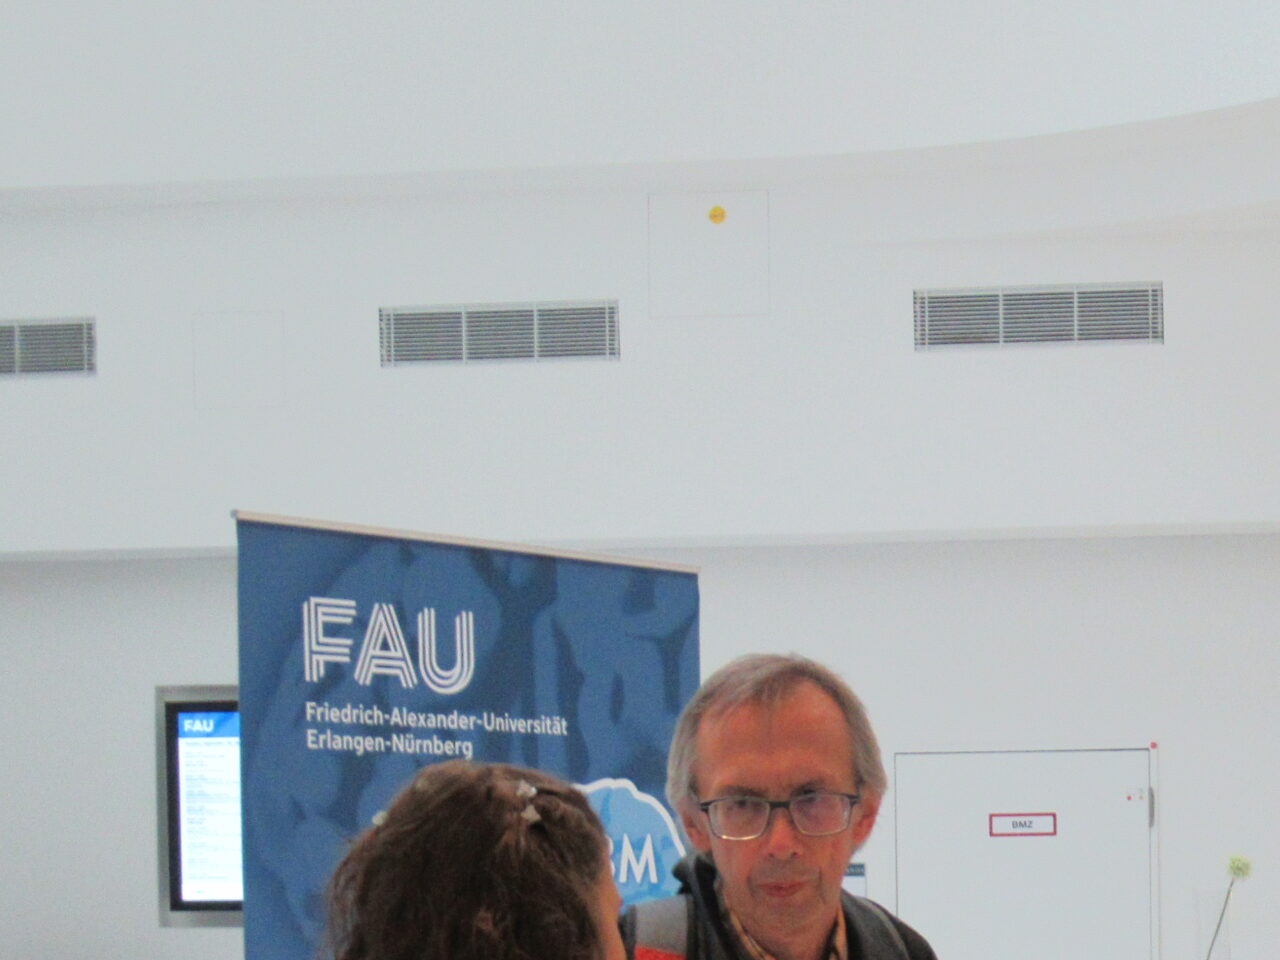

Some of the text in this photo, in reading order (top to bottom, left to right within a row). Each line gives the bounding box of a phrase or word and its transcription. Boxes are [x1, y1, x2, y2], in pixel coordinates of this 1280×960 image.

[303, 596, 475, 695] FAU
[183, 719, 214, 733] FAU
[305, 701, 568, 736] Friedrich-Alexander-Universität
[306, 729, 473, 760] Erlangen-Nürnberg
